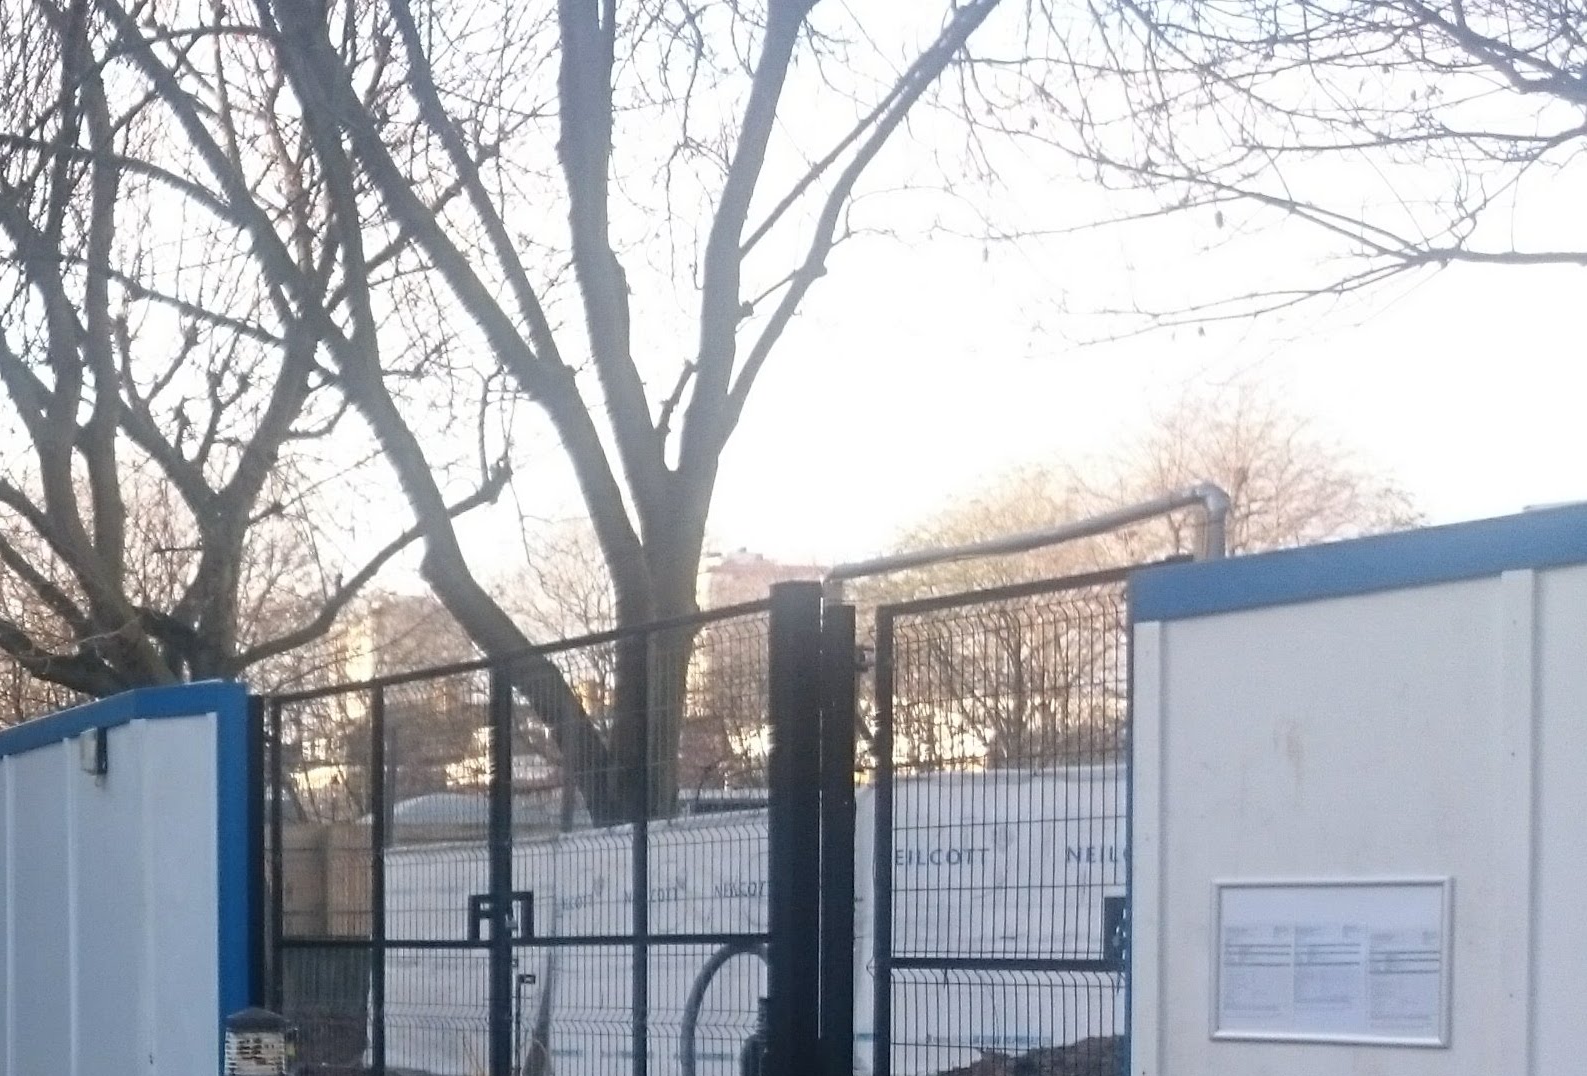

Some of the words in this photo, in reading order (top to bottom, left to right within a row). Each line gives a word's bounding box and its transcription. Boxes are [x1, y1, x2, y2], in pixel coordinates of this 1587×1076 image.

[893, 848, 990, 867] EILCOTT
[1066, 846, 1127, 865] NEIL
[714, 880, 768, 899] NEILCOT
